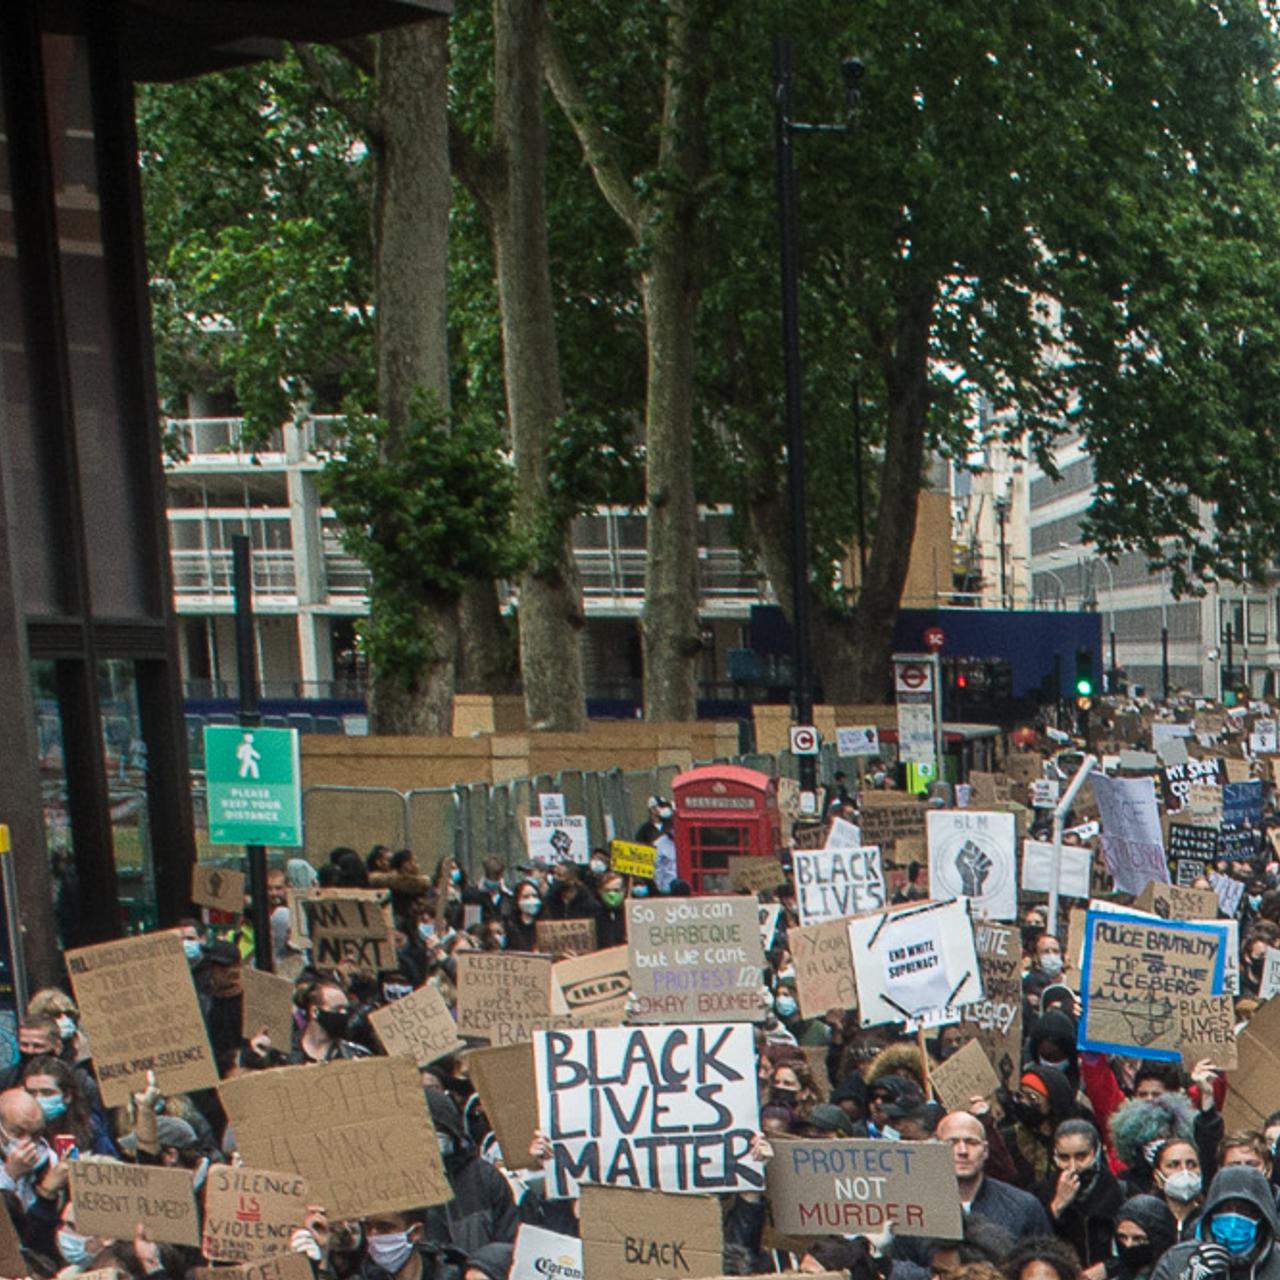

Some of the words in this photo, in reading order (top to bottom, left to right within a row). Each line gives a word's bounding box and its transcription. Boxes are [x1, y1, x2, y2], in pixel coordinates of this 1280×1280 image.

[230, 789, 269, 798] PLEASE
[224, 811, 278, 820] DISTANCE
[797, 851, 879, 885] BLACK
[800, 881, 884, 916] LIVES
[308, 900, 346, 928] AM
[632, 905, 655, 923] So
[665, 906, 699, 924] you
[701, 903, 733, 918] can
[319, 939, 385, 969] NEXT
[635, 951, 668, 967] but
[704, 949, 746, 964] cant
[906, 940, 934, 960] WHITE
[571, 976, 624, 1003] IKEA
[653, 968, 734, 992] PROTEST
[546, 1026, 744, 1092] BLACK
[550, 1083, 733, 1136] LIVES
[552, 1128, 765, 1197] MATTER
[791, 1147, 916, 1174] PROTECT
[218, 1173, 304, 1195] SILENCE
[834, 1178, 888, 1201] NOT
[239, 1198, 260, 1213] IS
[800, 1203, 926, 1229] MURDER
[208, 1221, 299, 1238] VIOLENCE
[625, 1236, 689, 1270] BLACK
